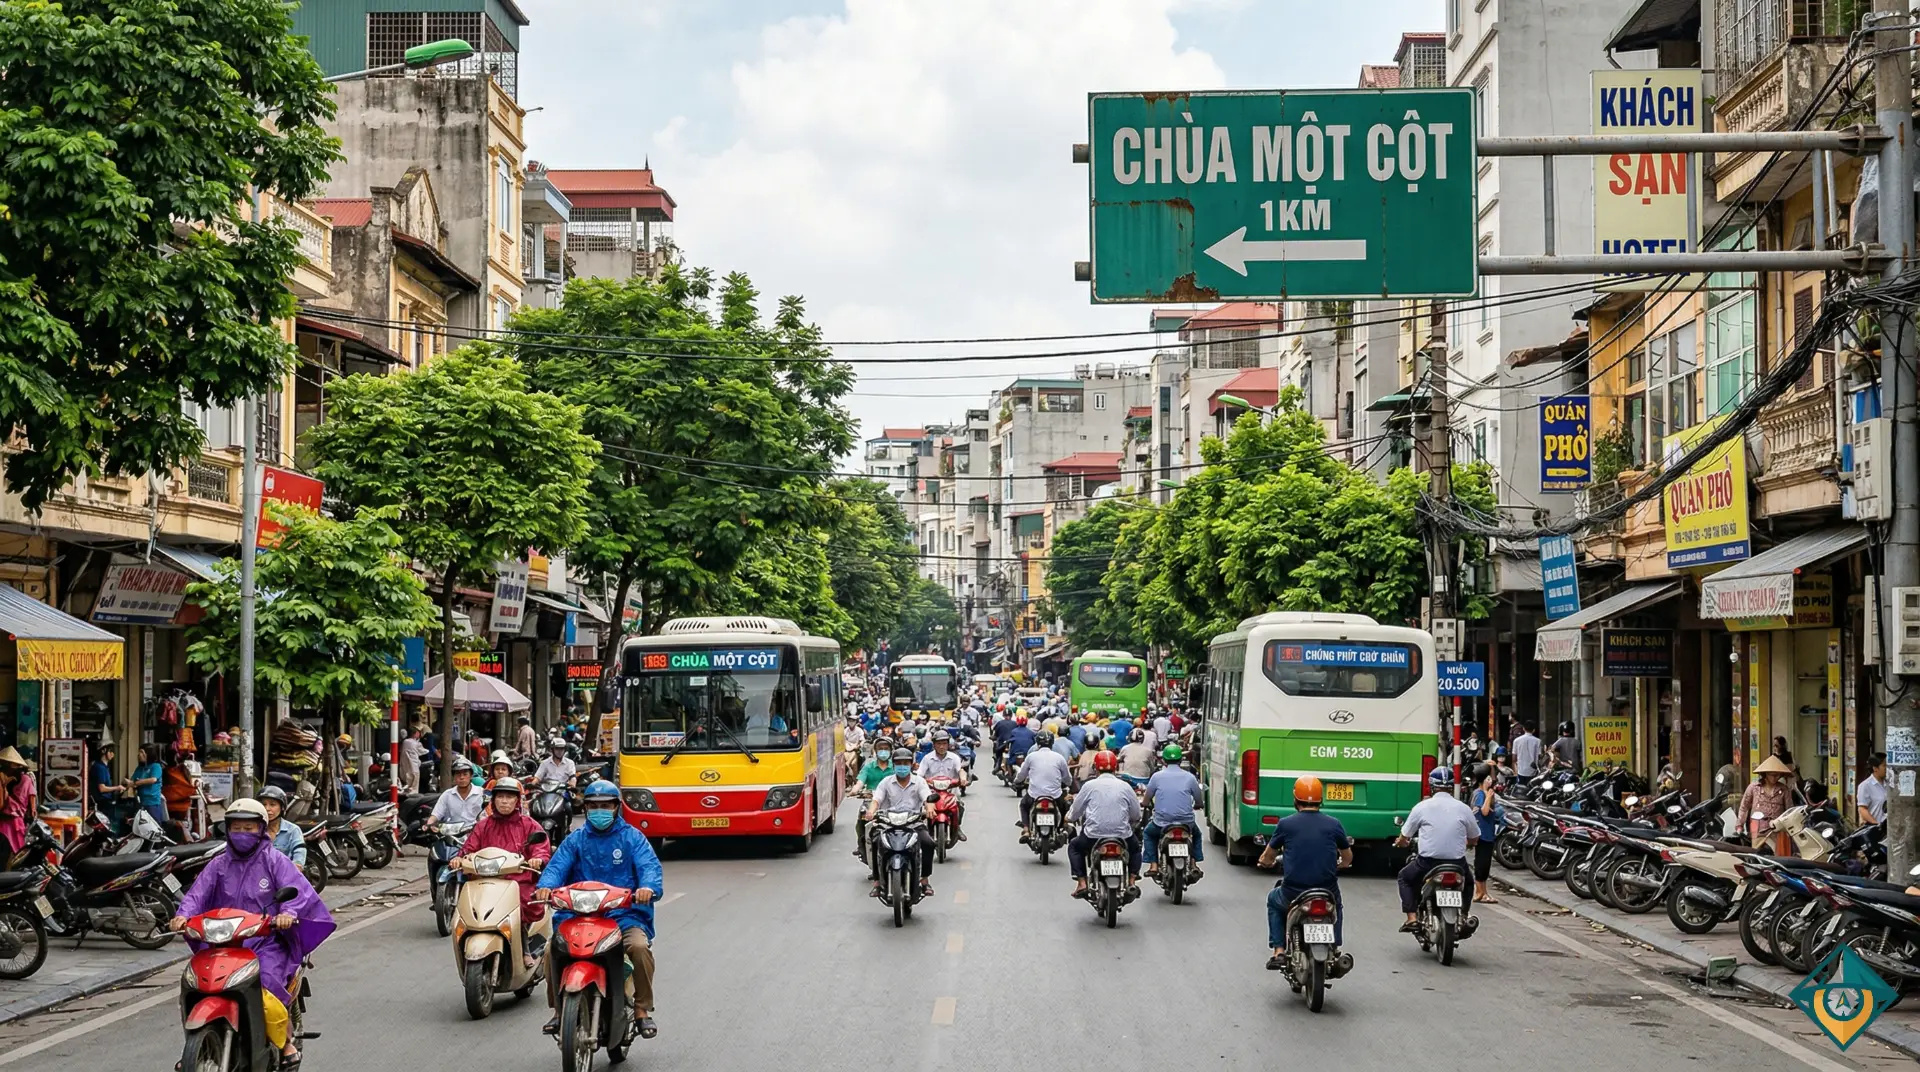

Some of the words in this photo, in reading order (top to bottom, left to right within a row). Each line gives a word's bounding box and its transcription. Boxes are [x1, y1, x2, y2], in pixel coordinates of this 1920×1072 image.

[1601, 78, 1694, 126] KHÁCH
[1113, 112, 1237, 185] CHÙA
[1252, 111, 1351, 195] MỘT
[1366, 109, 1453, 193] CỘT
[1609, 153, 1686, 205] SẠN
[1260, 199, 1331, 231] 1KM
[1544, 400, 1586, 424] QUÁN
[1544, 424, 1588, 461] PHỞ
[1610, 633, 1642, 646] KHÁCH
[671, 652, 709, 667] CHÙA
[713, 651, 744, 669] MỘT
[748, 651, 776, 668] CỘT
[1438, 677, 1480, 690] 20.500
[1310, 745, 1338, 758] EGM
